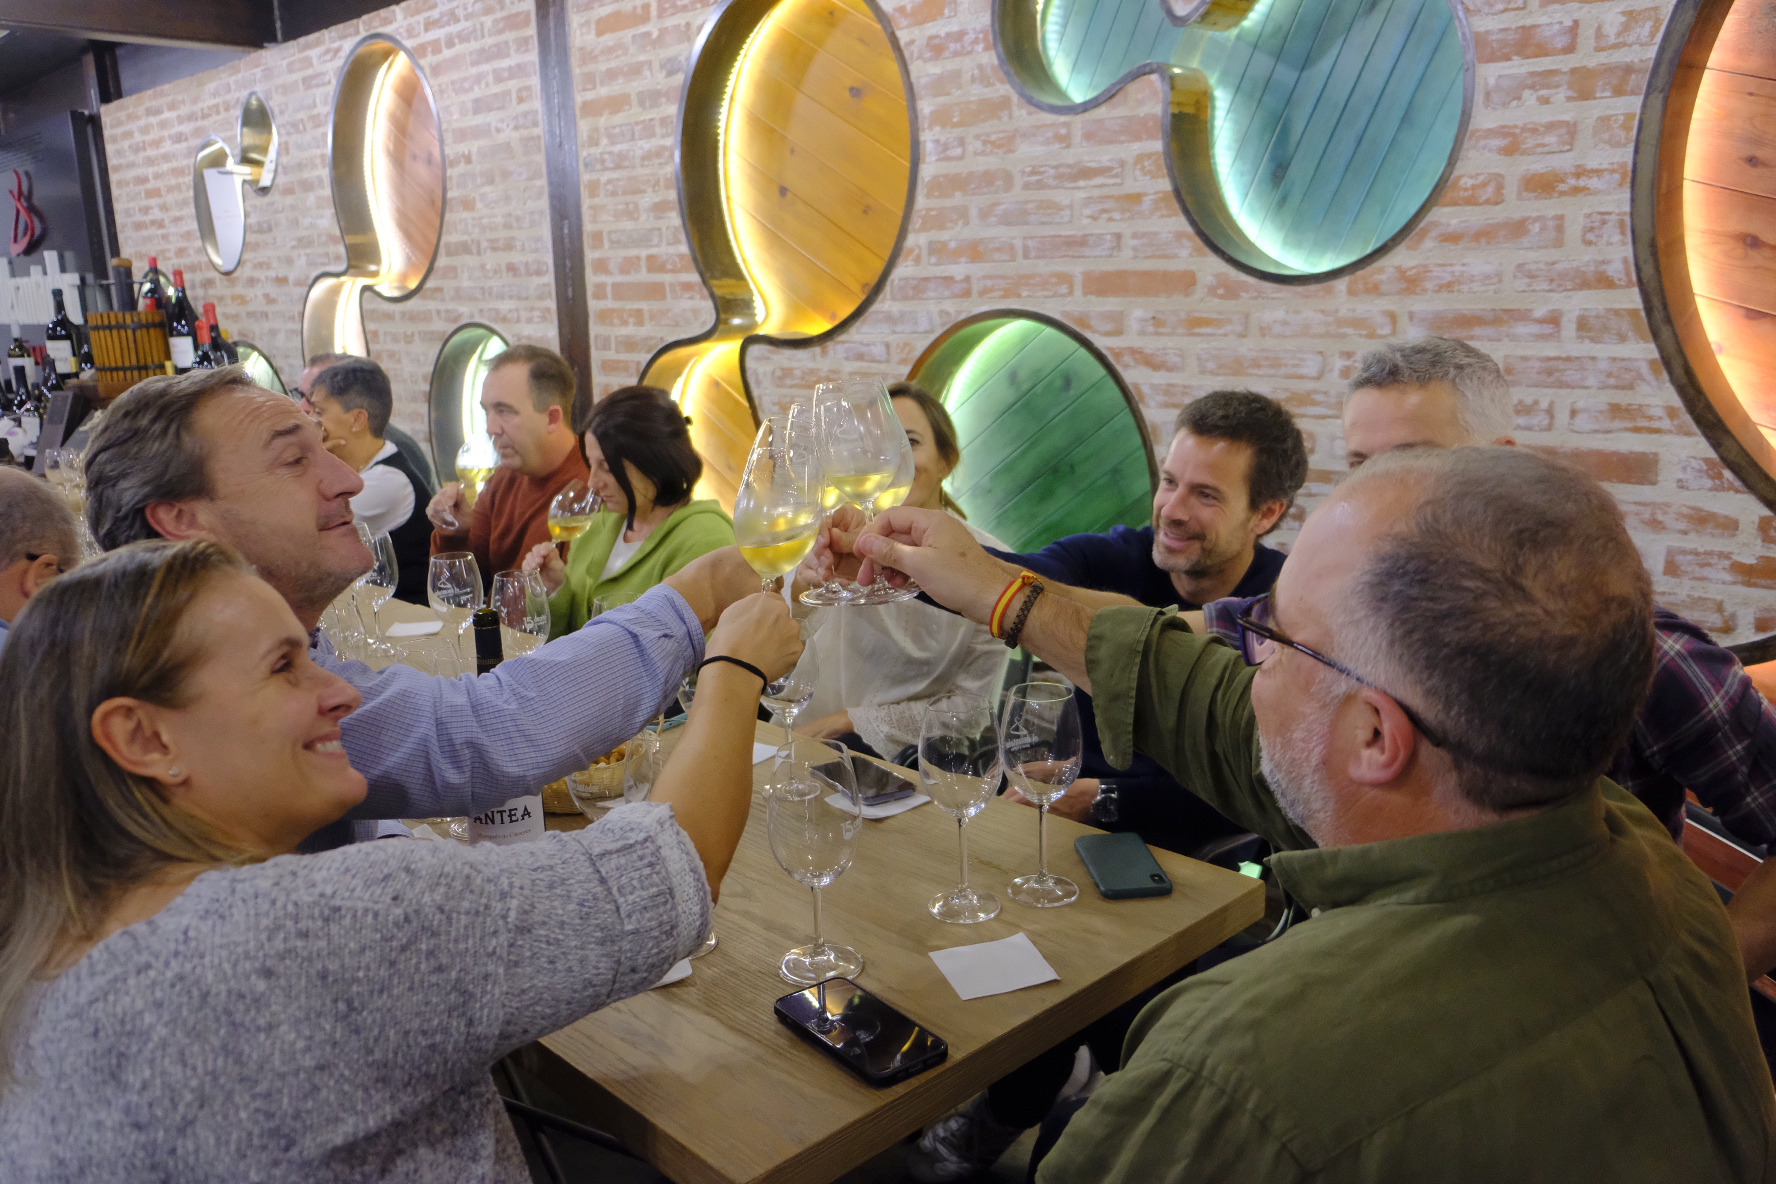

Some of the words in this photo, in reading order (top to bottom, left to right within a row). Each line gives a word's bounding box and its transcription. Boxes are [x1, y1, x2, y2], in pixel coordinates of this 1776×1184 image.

[523, 616, 534, 629] 15
[473, 804, 532, 825] ANTEA
[840, 820, 853, 840] 15
